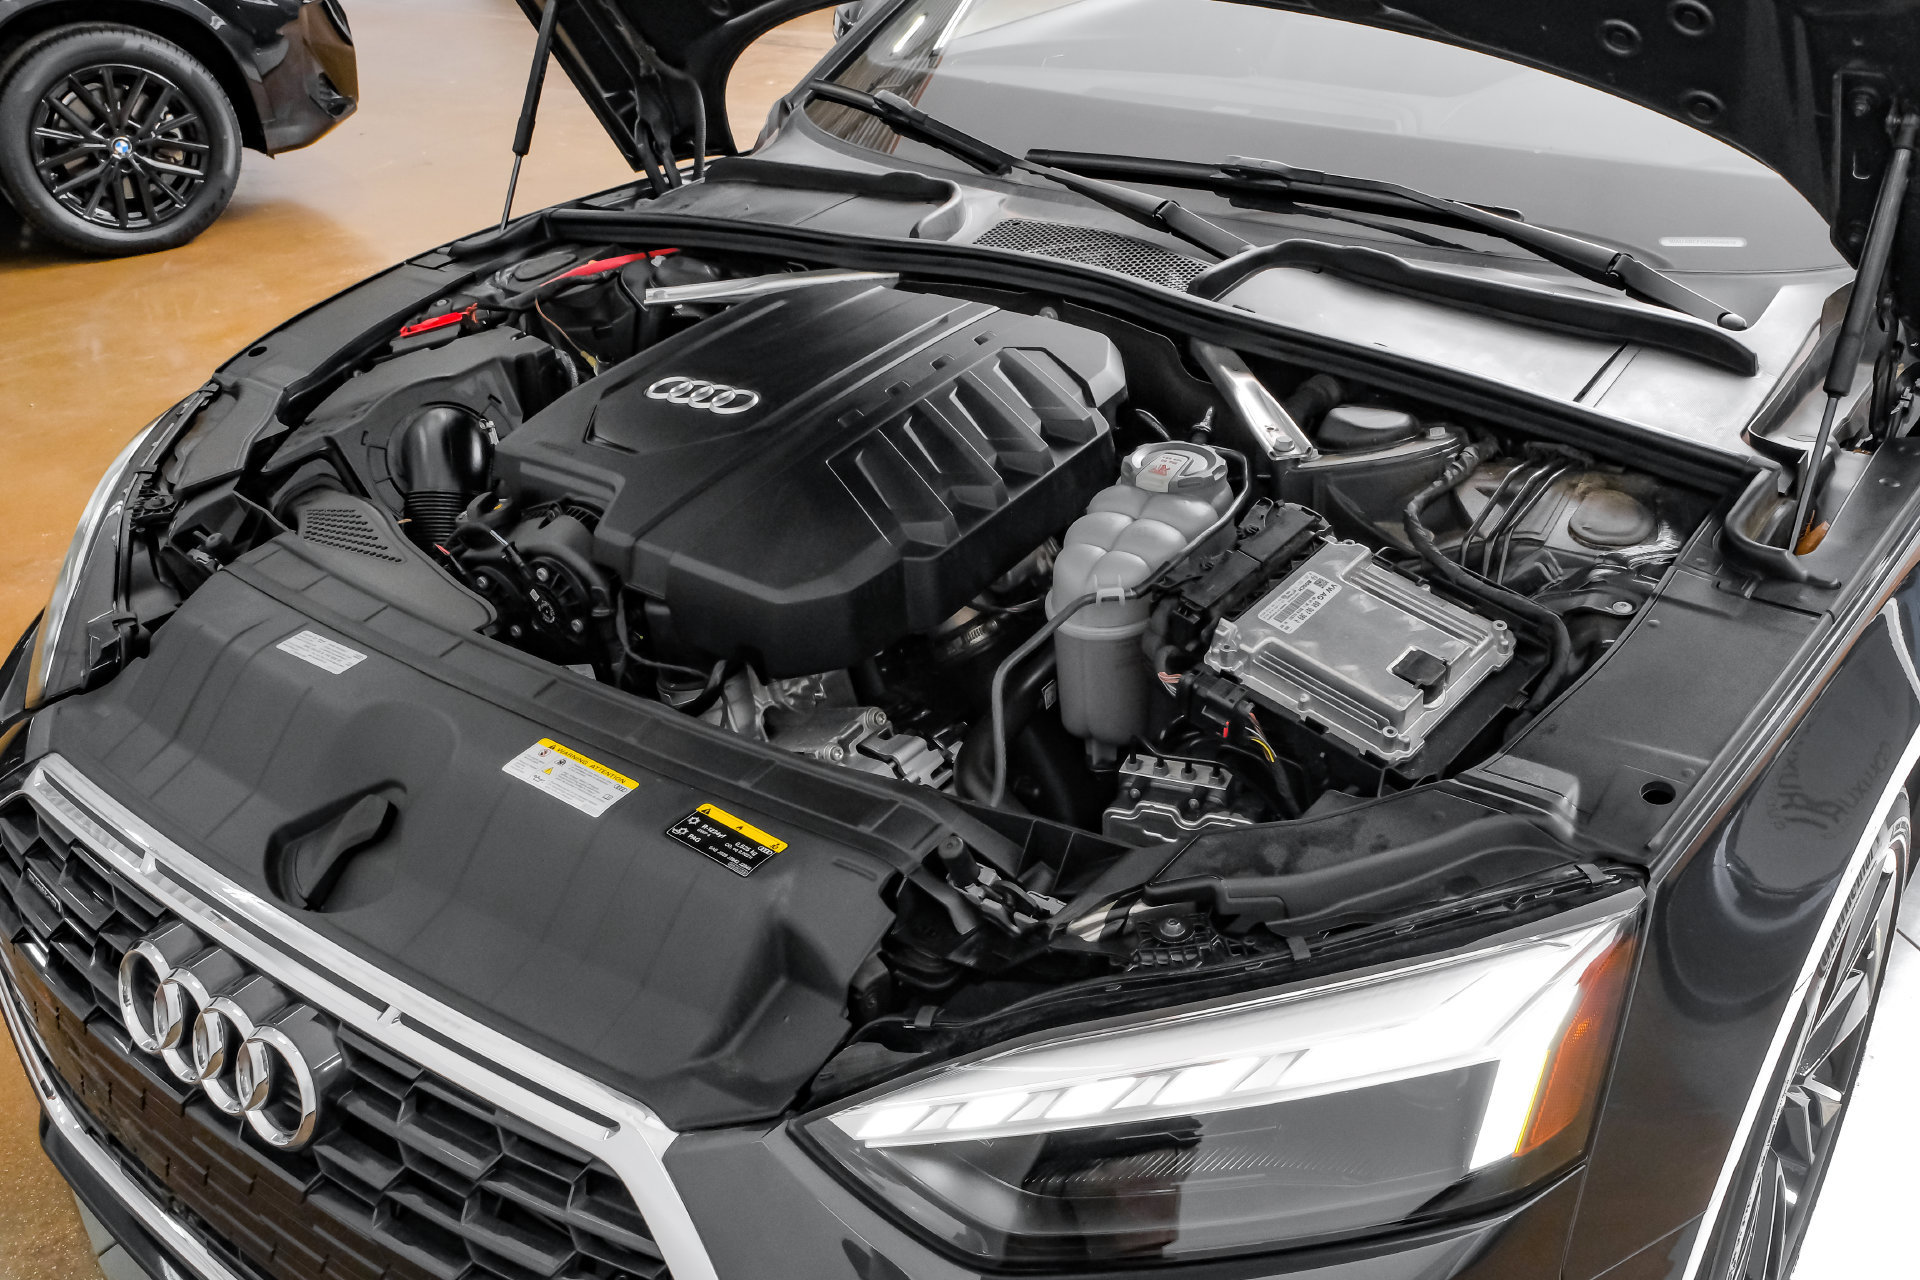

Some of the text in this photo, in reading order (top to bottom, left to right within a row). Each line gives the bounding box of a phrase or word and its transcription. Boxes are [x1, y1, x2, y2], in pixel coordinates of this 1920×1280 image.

[1326, 584, 1337, 594] VW
[1317, 592, 1327, 601] AG
[557, 747, 588, 766] WARNING
[589, 763, 627, 784] ATTENTION
[687, 833, 702, 843] PAG
